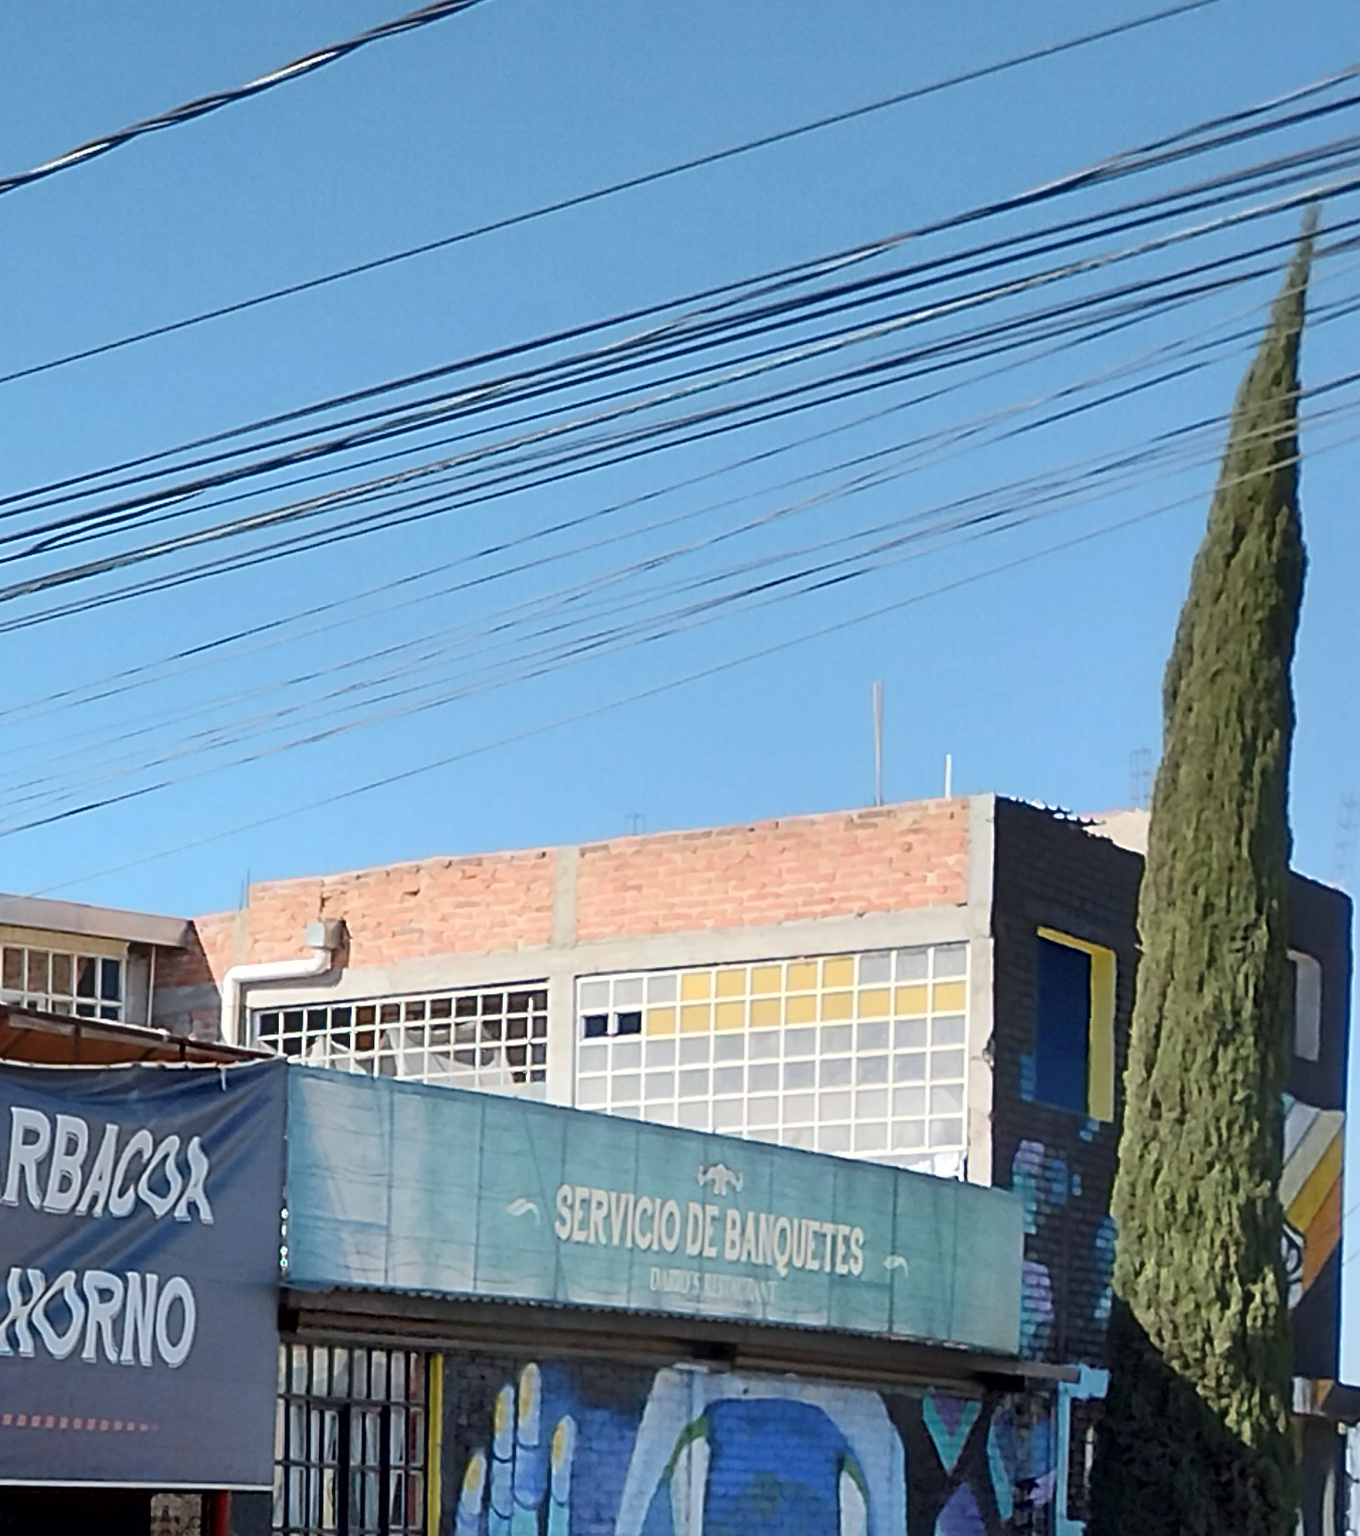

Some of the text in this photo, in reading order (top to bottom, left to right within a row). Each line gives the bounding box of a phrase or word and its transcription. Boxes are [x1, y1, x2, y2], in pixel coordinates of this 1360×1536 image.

[554, 1183, 866, 1278] SERVICIO DE BANQUETES
